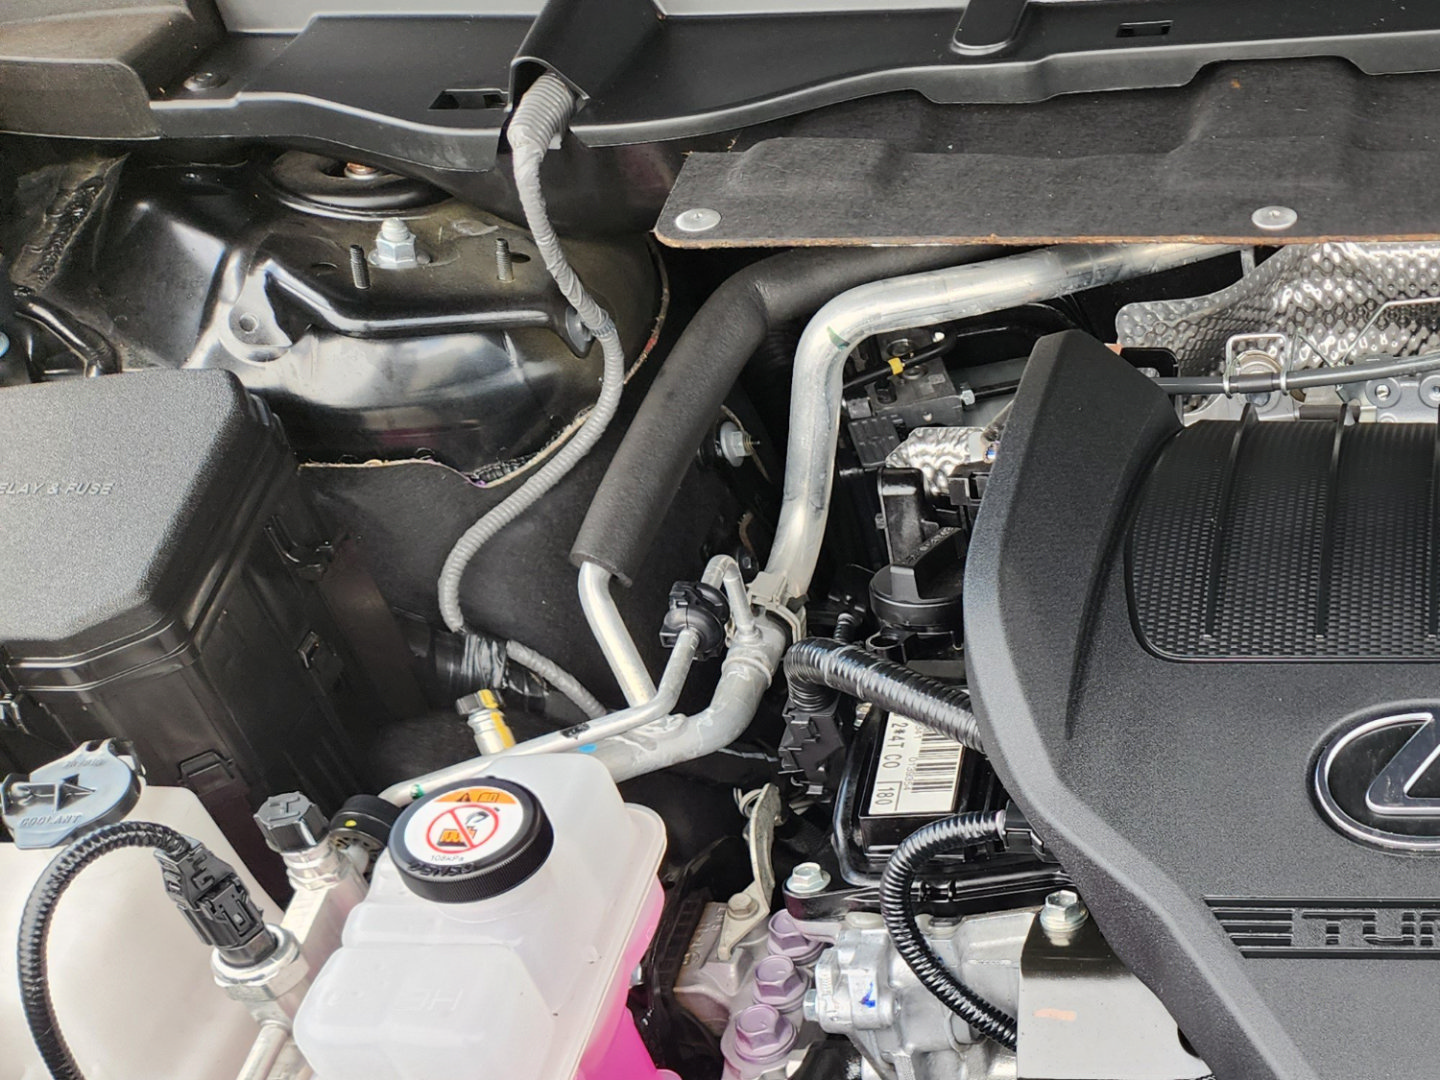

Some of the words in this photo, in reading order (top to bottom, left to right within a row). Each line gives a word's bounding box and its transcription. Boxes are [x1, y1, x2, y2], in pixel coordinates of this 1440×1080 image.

[0, 482, 45, 495] ELAY
[47, 483, 60, 495] &
[65, 482, 115, 495] FUSE
[874, 786, 895, 806] 180
[20, 814, 81, 827] COOLANT
